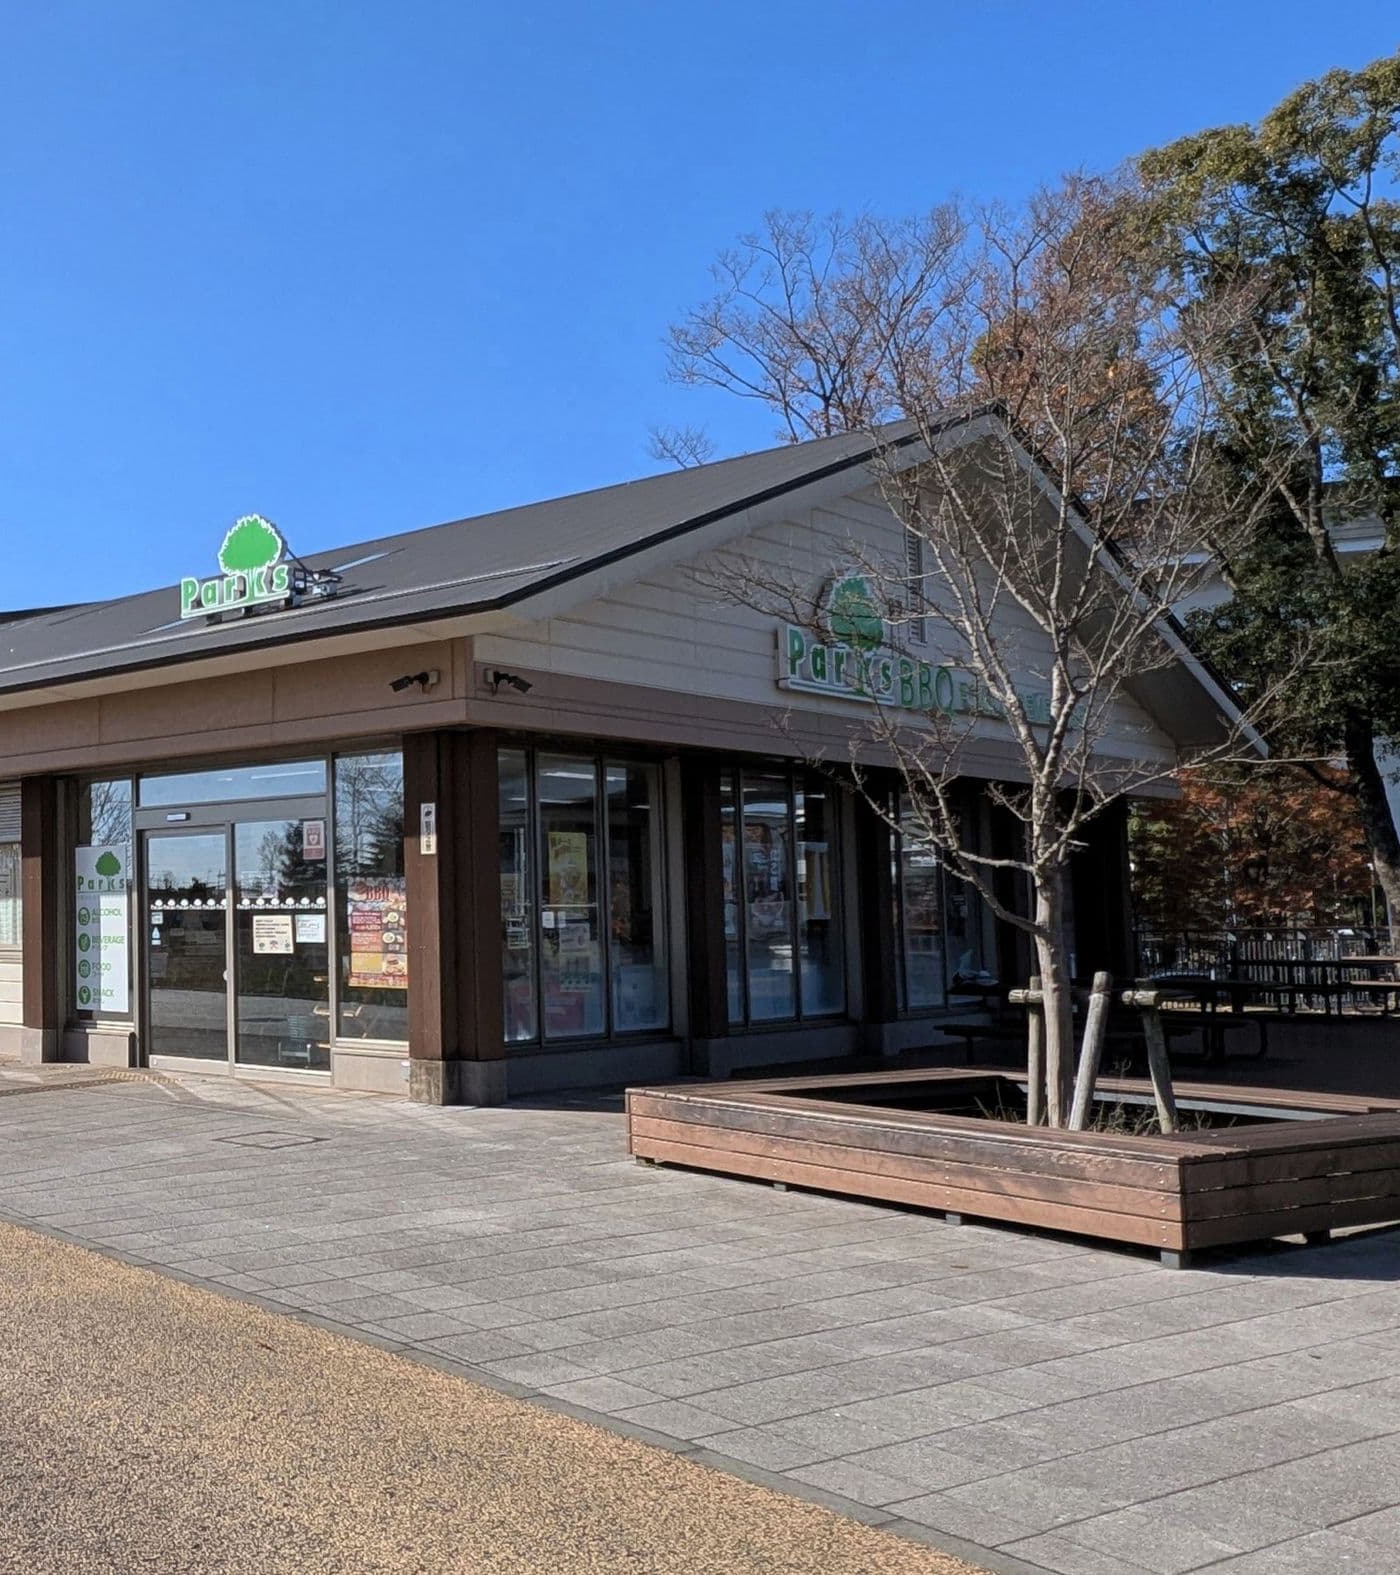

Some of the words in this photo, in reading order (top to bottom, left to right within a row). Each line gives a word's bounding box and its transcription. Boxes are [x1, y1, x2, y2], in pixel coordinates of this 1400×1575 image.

[181, 565, 289, 611] Parks
[787, 627, 895, 694] Parks
[77, 875, 125, 890] Parks
[91, 908, 122, 917] ALCOHOL
[91, 935, 126, 944] BEVERAGE
[92, 962, 111, 971] FOOD
